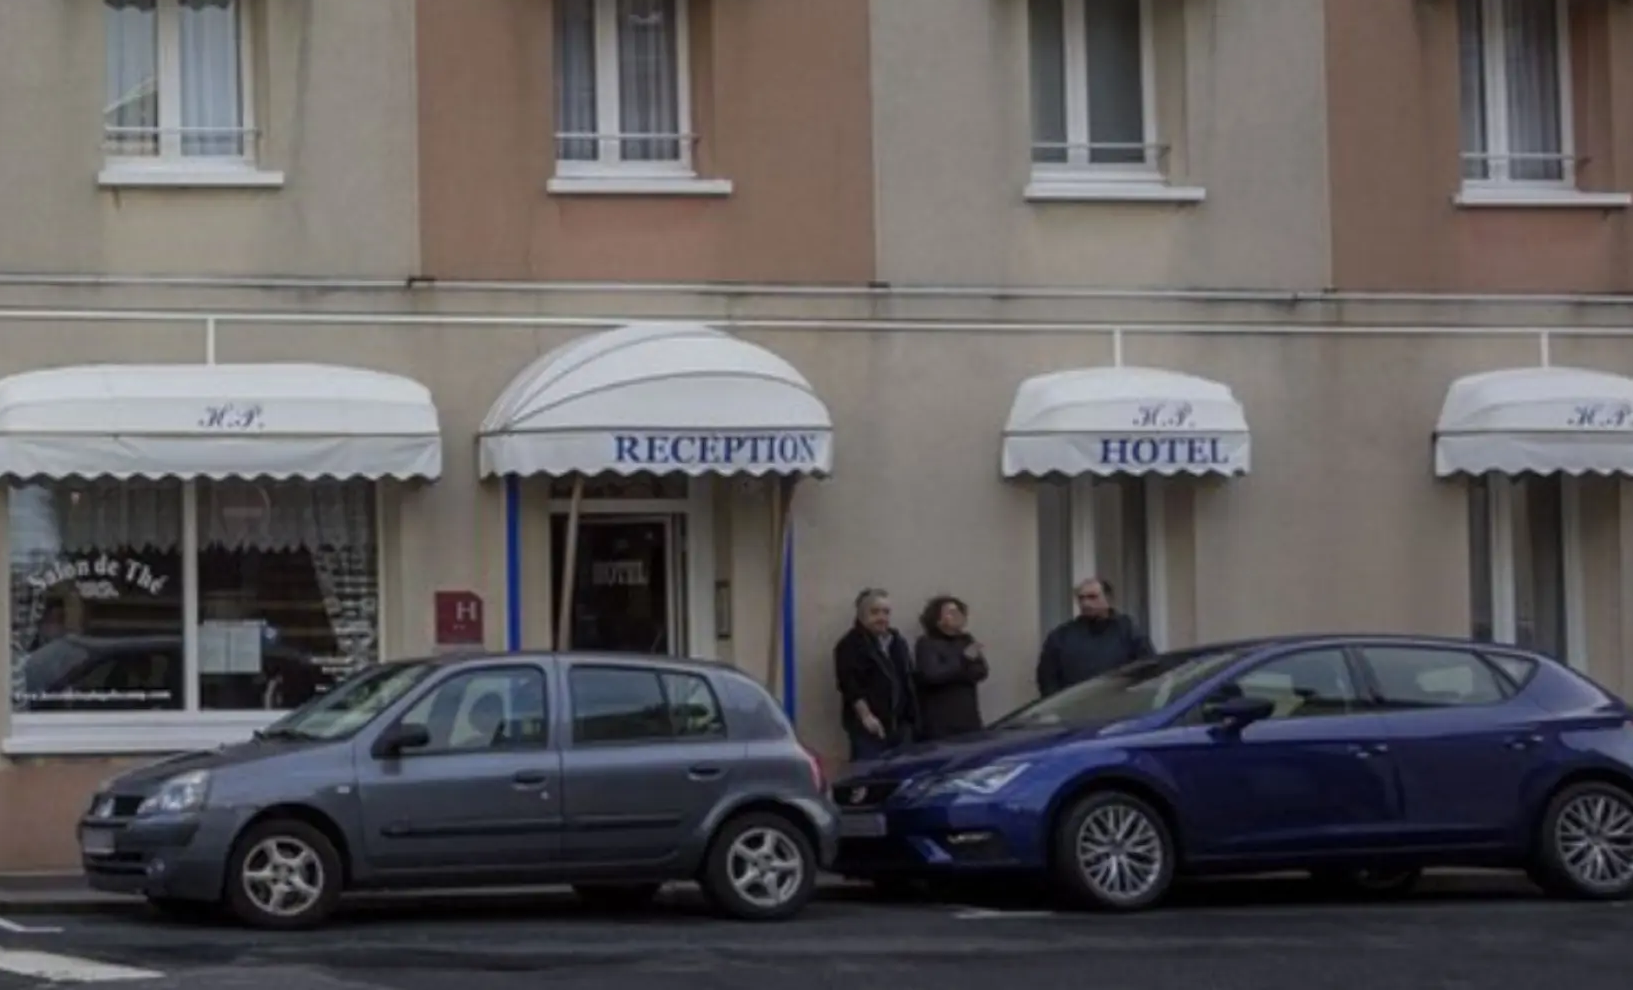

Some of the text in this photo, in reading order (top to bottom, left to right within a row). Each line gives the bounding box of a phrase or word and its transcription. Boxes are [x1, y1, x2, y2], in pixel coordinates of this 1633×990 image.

[615, 433, 816, 465] RECEPTION
[1100, 436, 1230, 465] HOTEL
[94, 553, 119, 576] de
[456, 601, 477, 622] H
